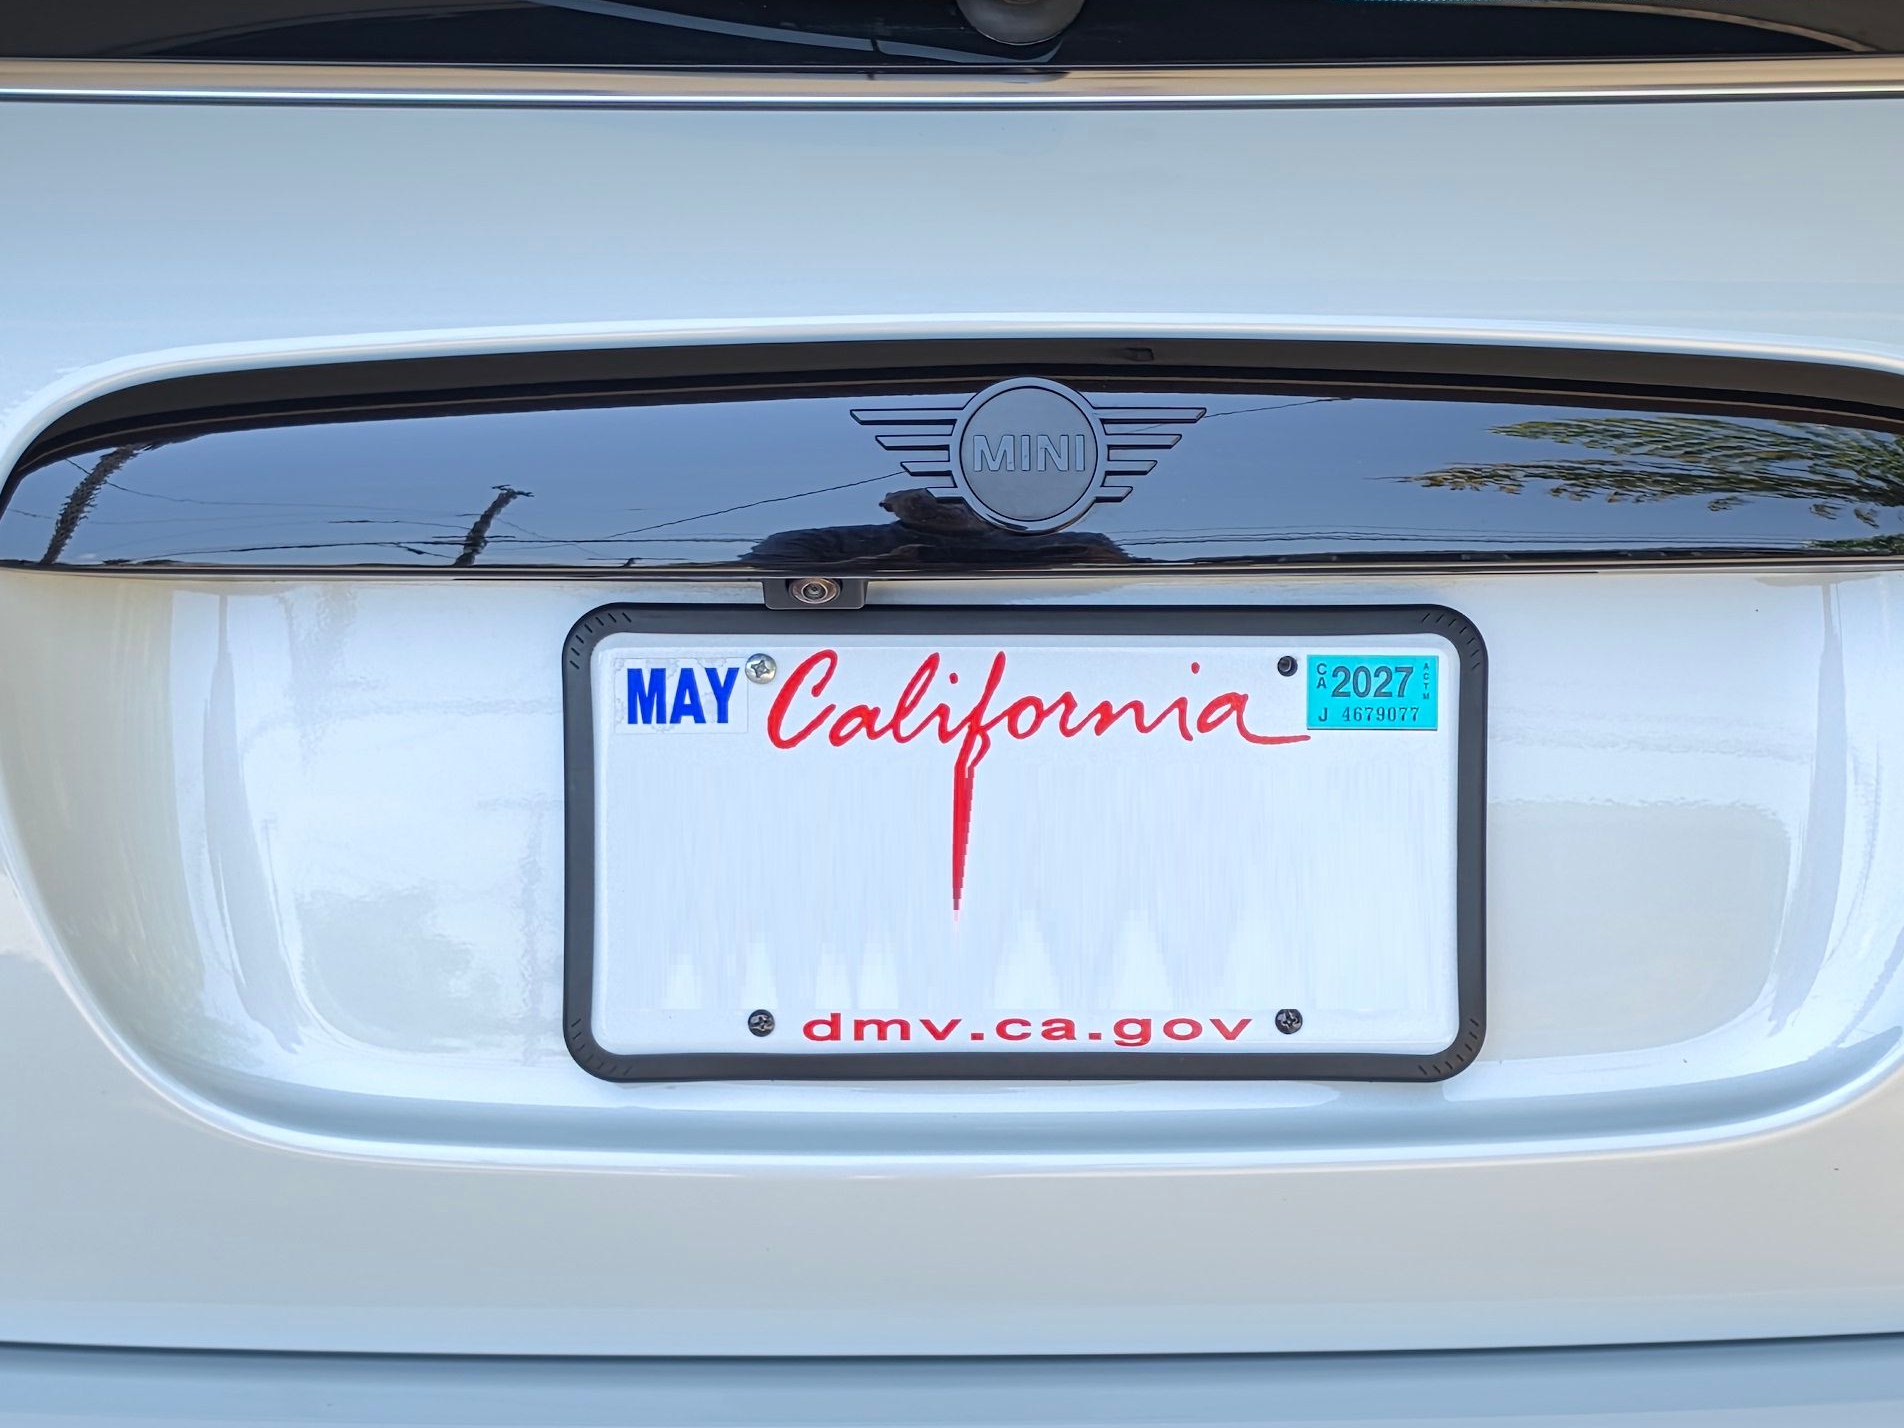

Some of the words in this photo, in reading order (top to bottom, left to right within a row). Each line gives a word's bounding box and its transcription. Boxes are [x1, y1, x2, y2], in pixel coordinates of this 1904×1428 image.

[972, 433, 1086, 472] MINI
[626, 667, 740, 725] MAY
[1331, 665, 1415, 698] 2027
[1318, 707, 1329, 722] J
[1341, 706, 1420, 722] 4679077
[801, 1012, 1254, 1048] dmv.ca.gov
